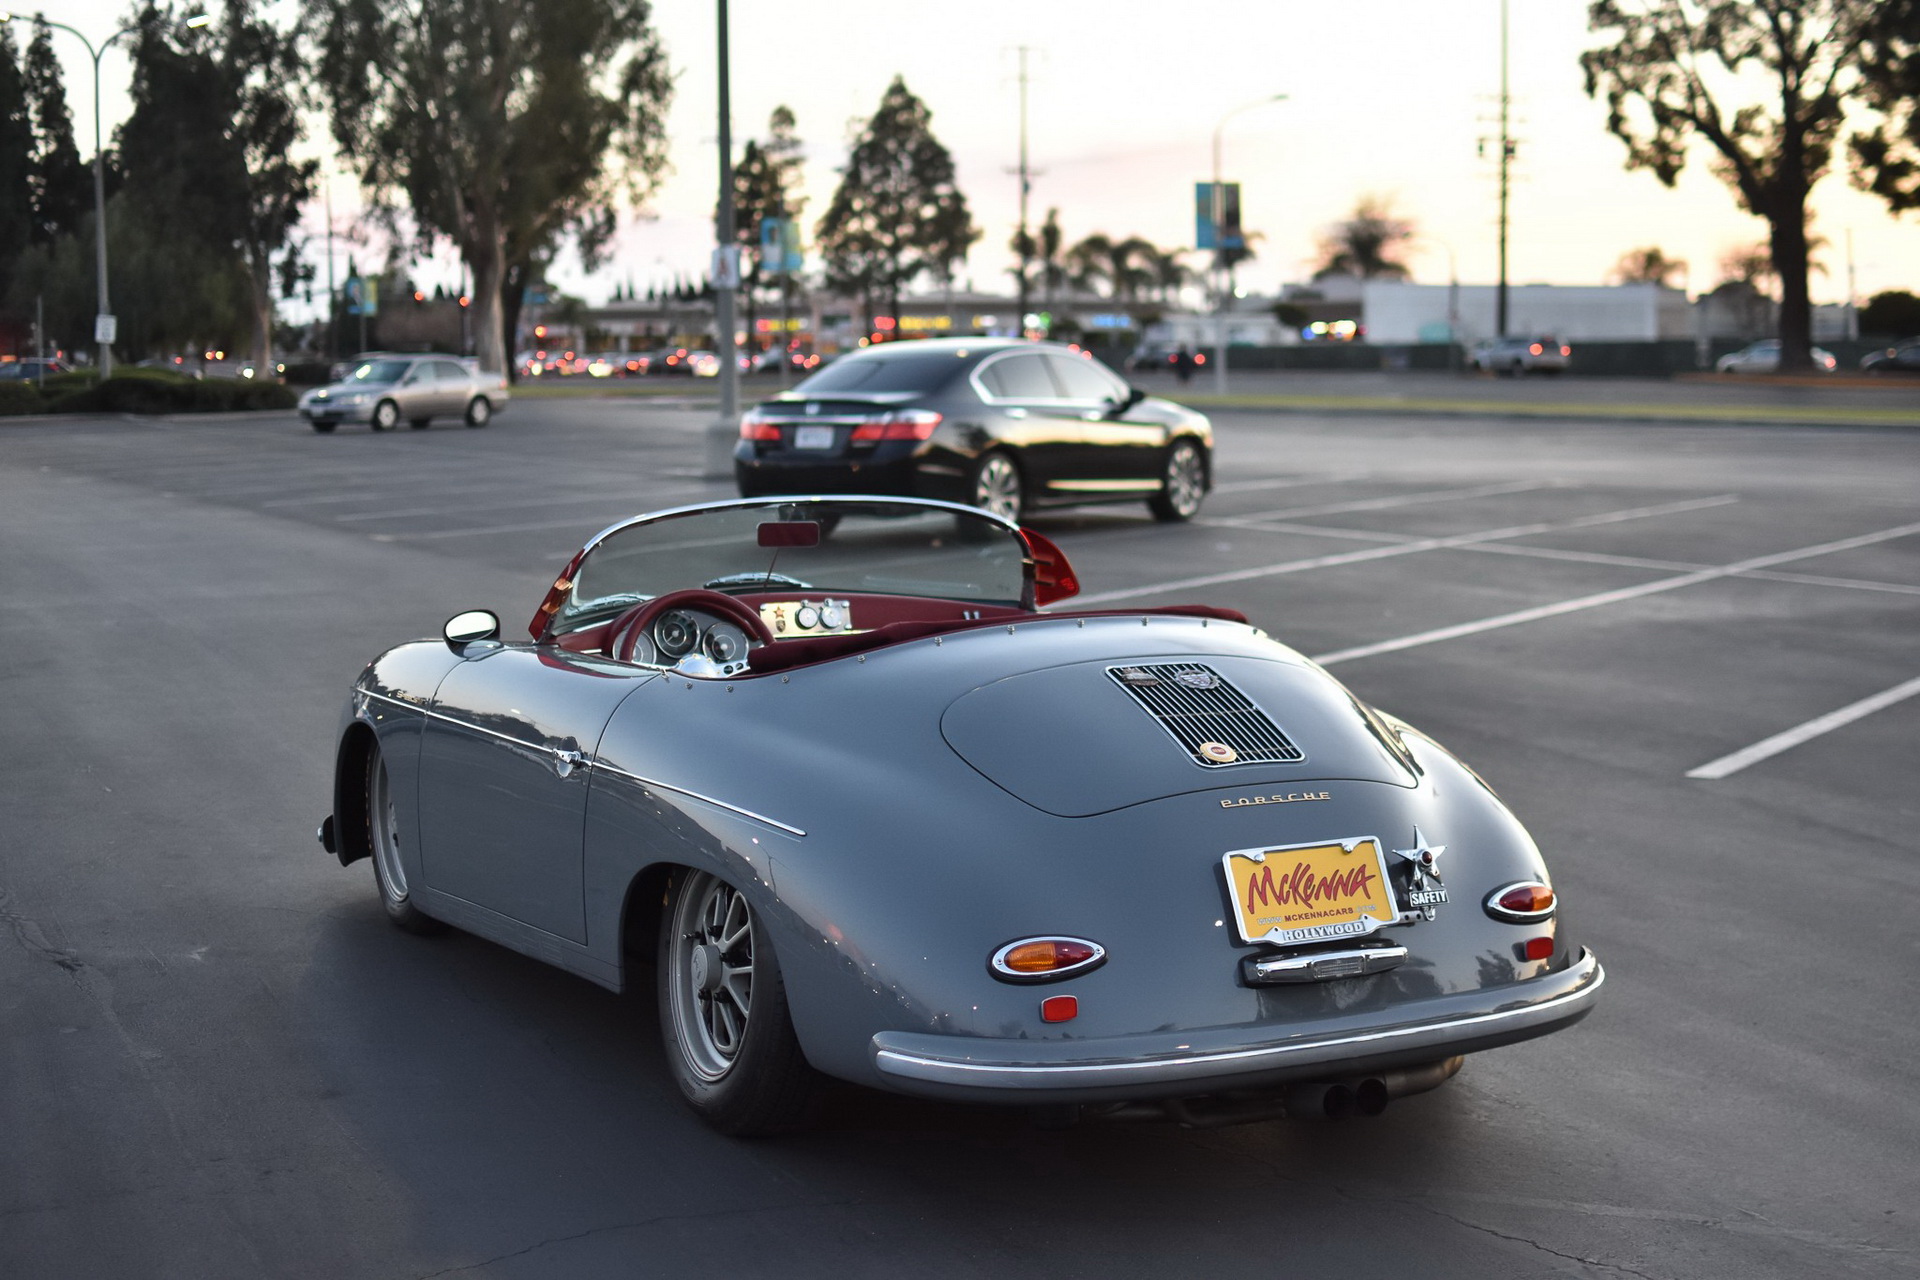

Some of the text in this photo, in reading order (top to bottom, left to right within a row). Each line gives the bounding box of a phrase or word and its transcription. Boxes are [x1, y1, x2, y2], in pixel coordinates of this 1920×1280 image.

[1221, 792, 1331, 808] PORSCHE
[1412, 891, 1446, 905] SAFETY
[1284, 921, 1364, 941] HOLLYWOOD
